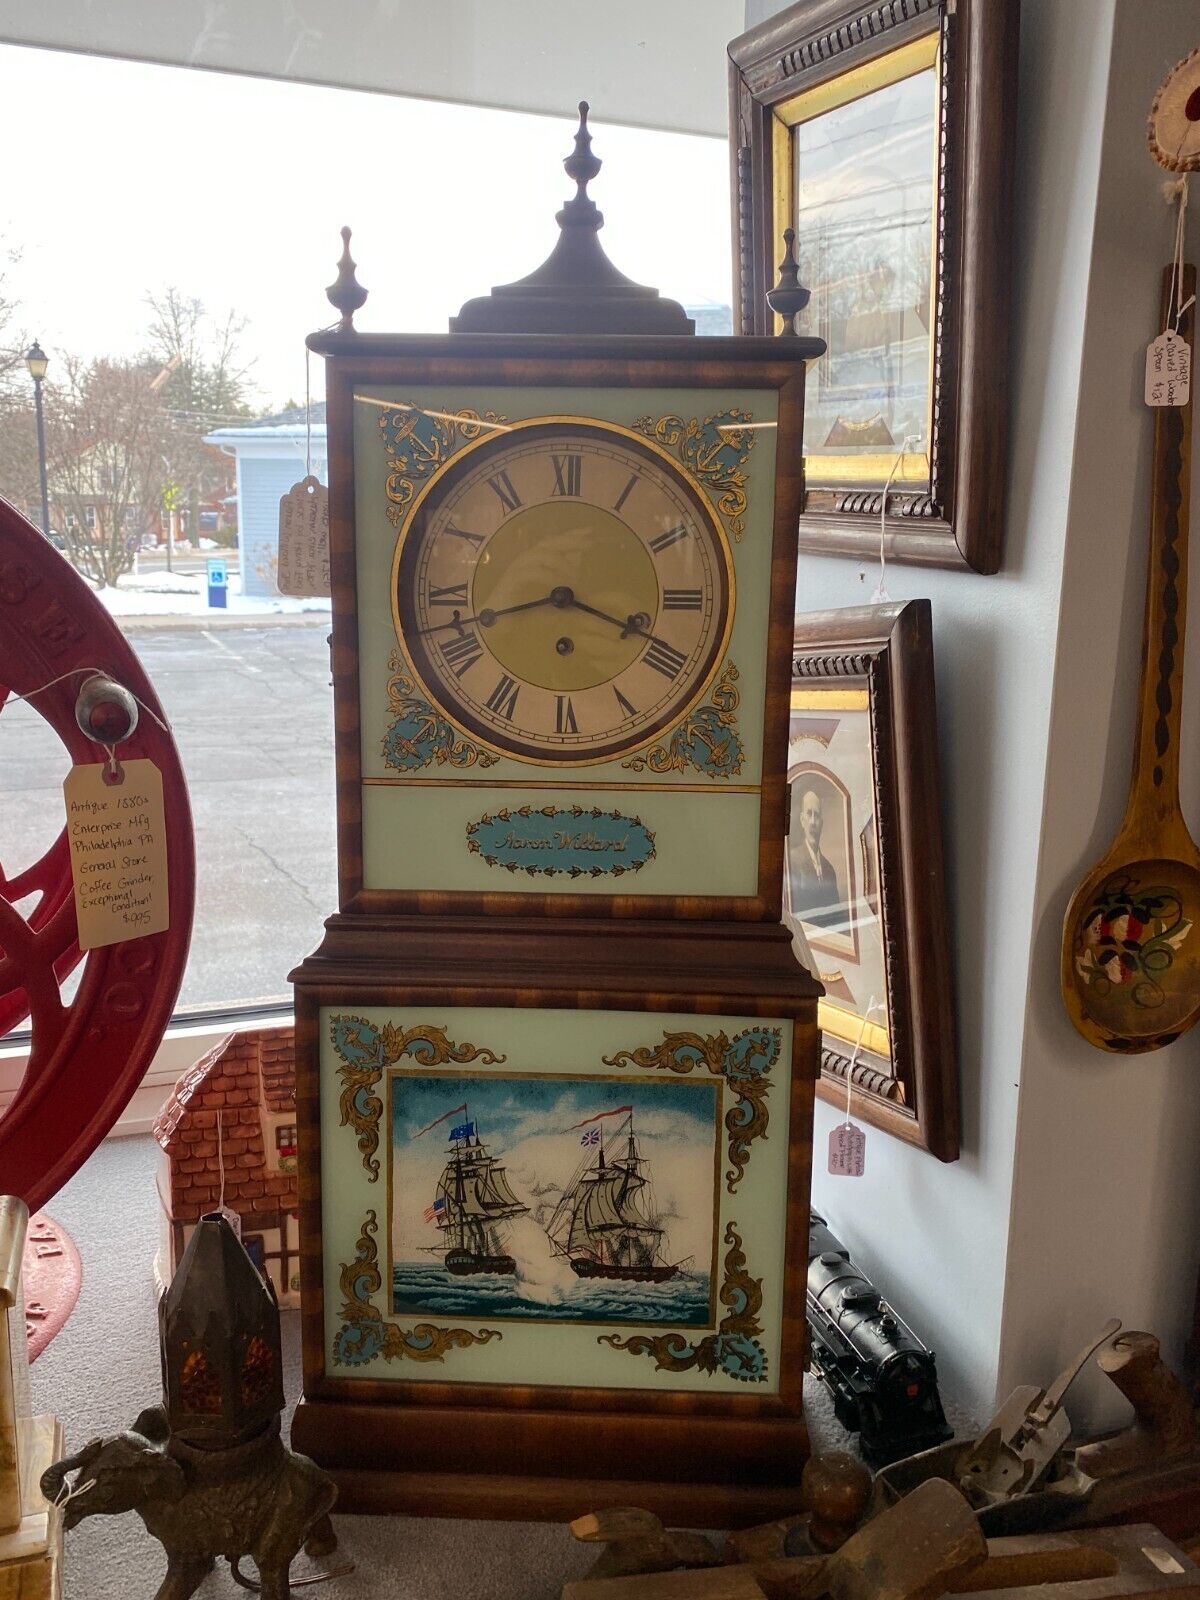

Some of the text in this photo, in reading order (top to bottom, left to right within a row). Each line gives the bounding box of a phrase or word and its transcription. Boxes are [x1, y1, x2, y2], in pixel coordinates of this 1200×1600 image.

[1166, 344, 1177, 371] Carved
[1176, 349, 1188, 386] Vintage
[551, 455, 582, 496] XII
[487, 470, 523, 515] XI
[612, 474, 639, 511] I
[445, 520, 484, 552] X
[650, 524, 686, 553] II
[428, 582, 468, 607] IX
[664, 586, 702, 610] III
[439, 632, 483, 679] VIII
[641, 639, 689, 681] IIII
[483, 673, 520, 722] VII
[613, 685, 640, 720] V
[554, 695, 578, 734] VI
[71, 800, 108, 814] Antique
[73, 814, 150, 835] Enterprise Mfg
[73, 838, 132, 853] Philadelphia
[495, 831, 629, 852] Aaron Willard
[80, 855, 148, 874] General Store
[80, 881, 112, 895] Coffee
[82, 890, 133, 909] Exceptional
[123, 910, 151, 928] $995
